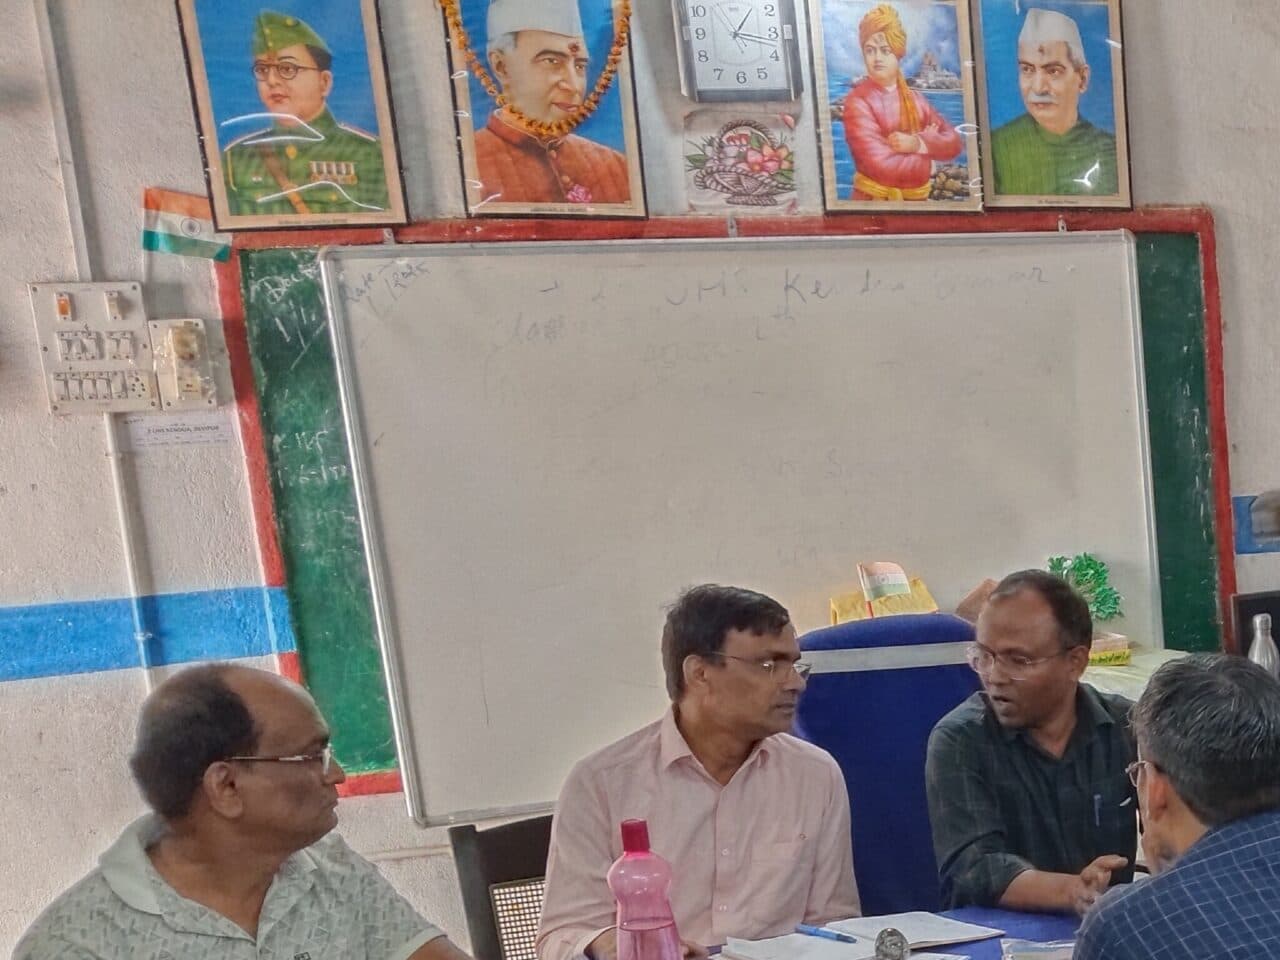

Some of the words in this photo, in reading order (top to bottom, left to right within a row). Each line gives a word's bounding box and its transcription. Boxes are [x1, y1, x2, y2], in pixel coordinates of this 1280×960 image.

[690, 5, 706, 17] 10
[764, 4, 776, 16] 2
[695, 27, 706, 40] 9
[768, 27, 779, 40] 3
[698, 50, 709, 62] 8
[769, 49, 779, 61] 4
[713, 68, 724, 80] 7
[736, 71, 747, 84] 6
[756, 67, 768, 80] 5
